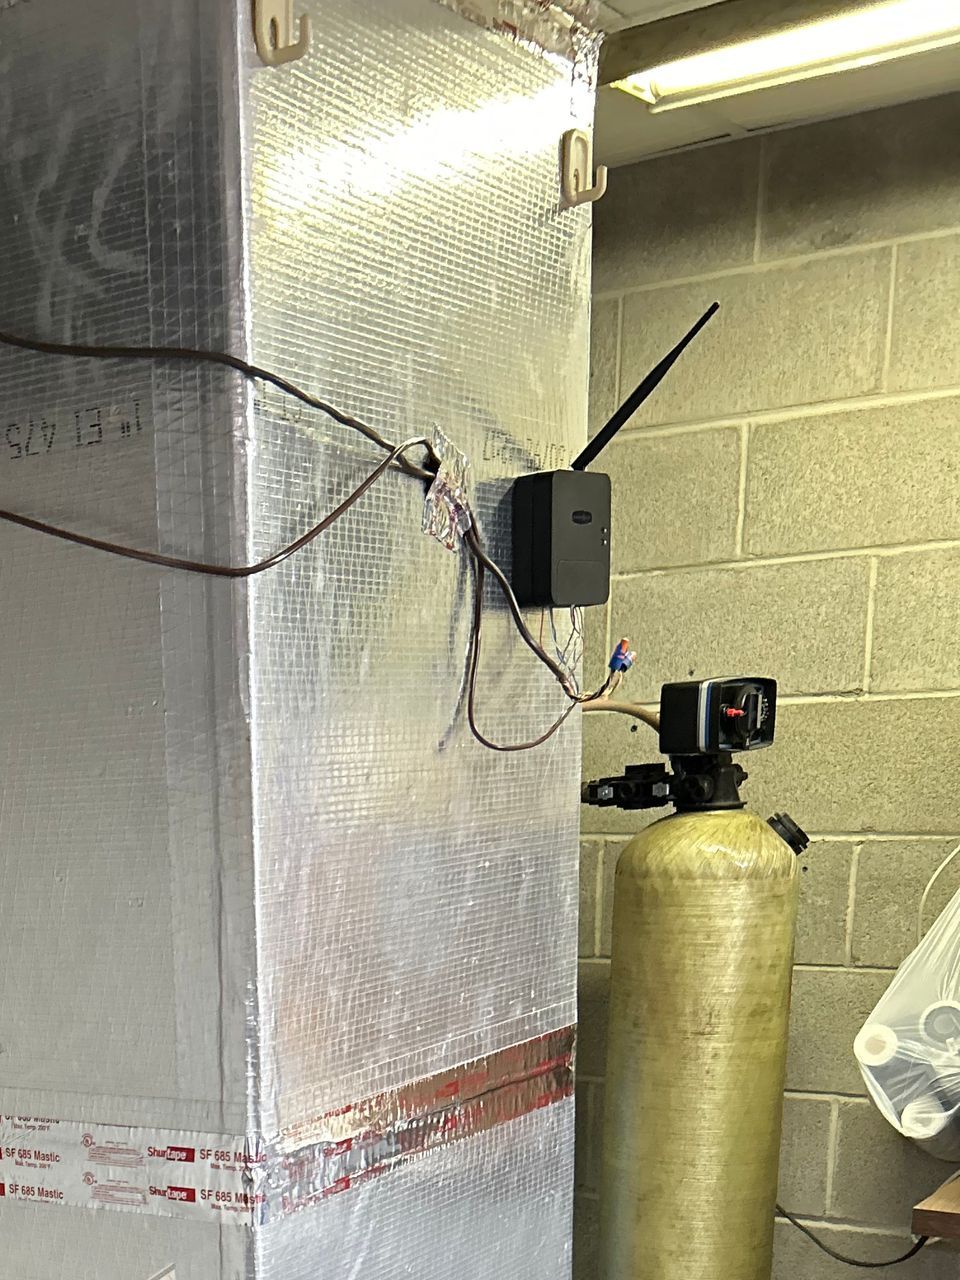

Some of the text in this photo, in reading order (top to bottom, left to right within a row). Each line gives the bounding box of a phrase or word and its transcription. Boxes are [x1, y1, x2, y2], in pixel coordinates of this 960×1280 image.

[4, 416, 57, 460] 475
[5, 1148, 16, 1158] SF
[18, 1149, 32, 1159] 685
[34, 1150, 60, 1162] Mastic
[147, 1146, 187, 1160] Shurtape
[200, 1148, 212, 1160] SF
[214, 1150, 231, 1162] 685
[9, 1184, 19, 1195] SF
[21, 1185, 35, 1196] 685
[38, 1187, 64, 1200] Mastic
[149, 1186, 187, 1200] Shurtape
[200, 1189, 213, 1200] SF
[215, 1191, 232, 1202] 685
